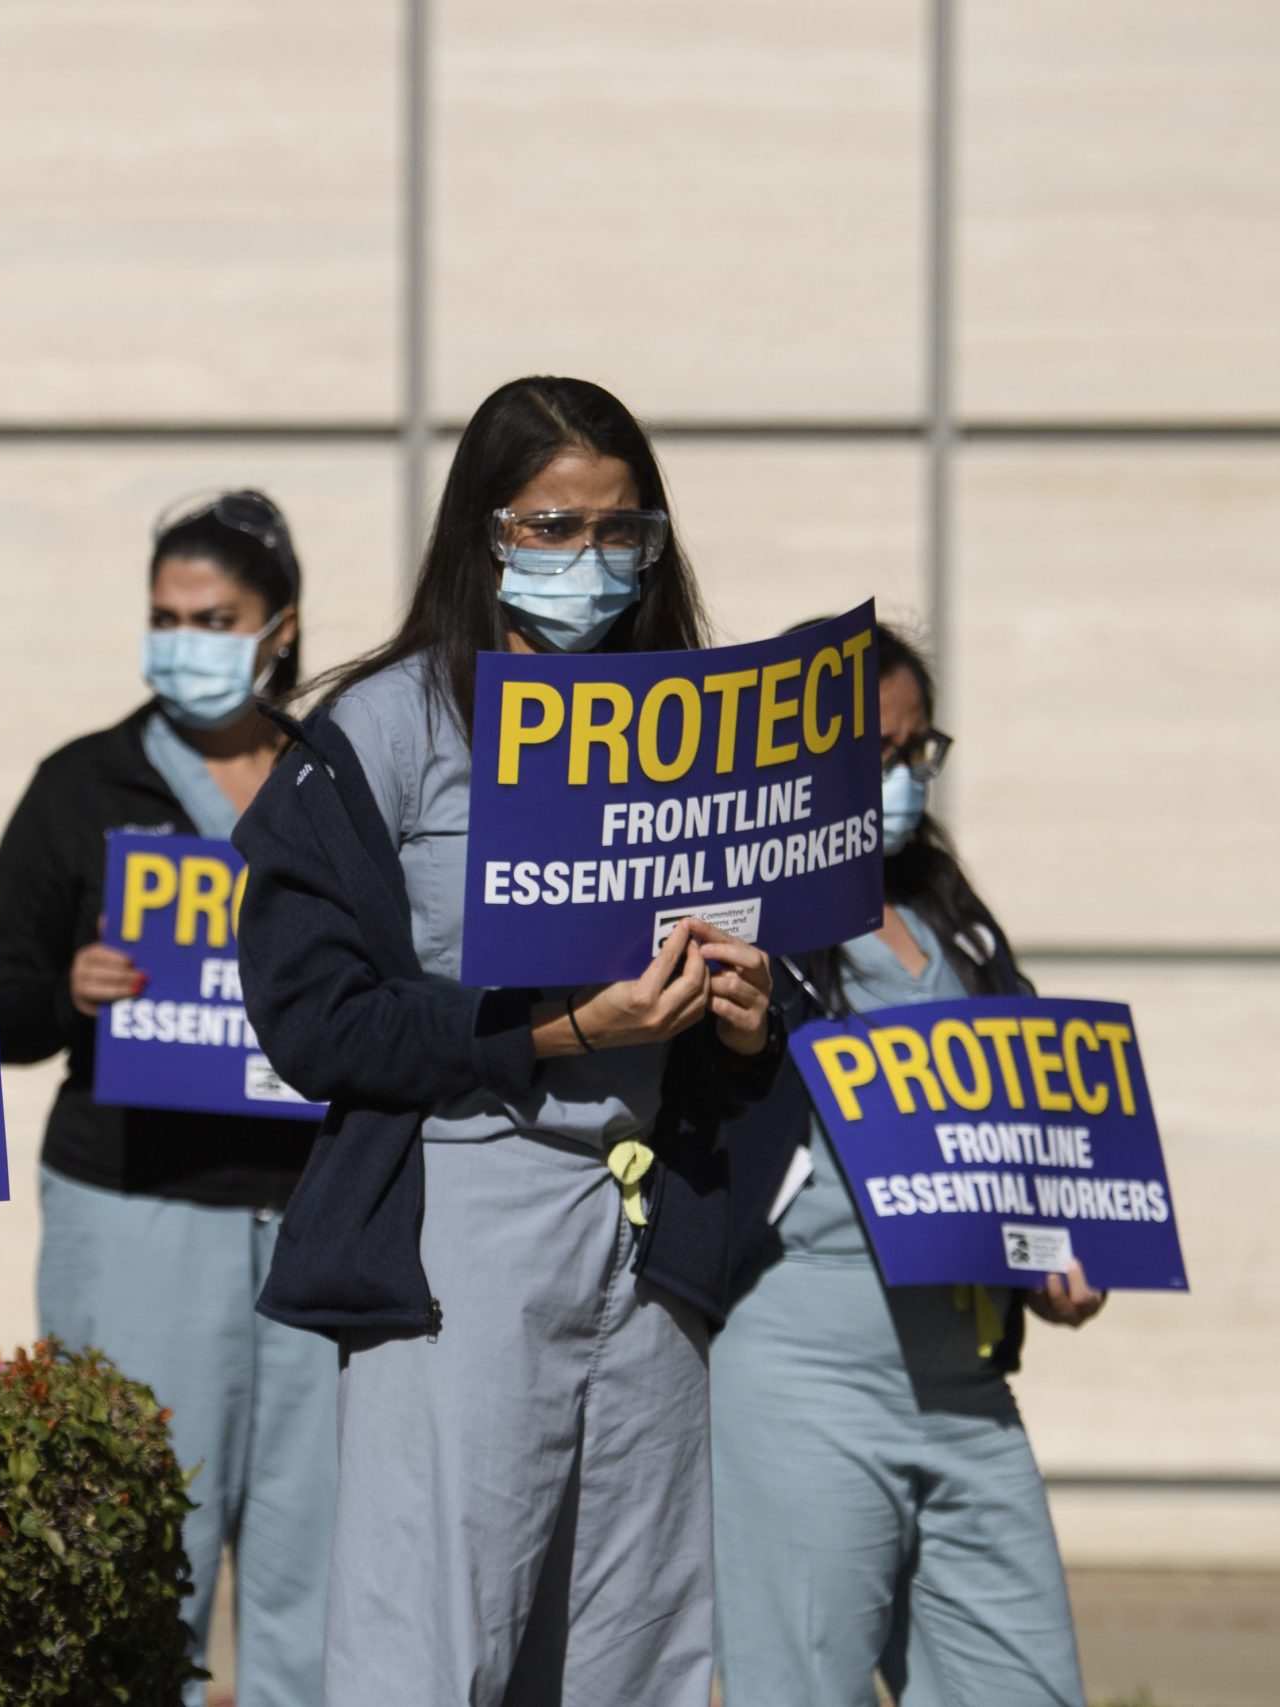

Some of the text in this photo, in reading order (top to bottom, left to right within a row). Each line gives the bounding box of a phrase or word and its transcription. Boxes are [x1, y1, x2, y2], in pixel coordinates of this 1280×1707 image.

[497, 630, 872, 785] PROTECT
[601, 775, 812, 846] FRONTLINE
[484, 809, 878, 905] ESSENTIAL WORKERS
[701, 906, 755, 920] Committee of
[731, 917, 747, 925] and
[110, 998, 261, 1050] ESSENTI
[812, 1017, 1136, 1121] PROTECT
[935, 1122, 1094, 1169] FRONTLINE
[866, 1171, 1169, 1222] ESSENTIAL WORKERS
